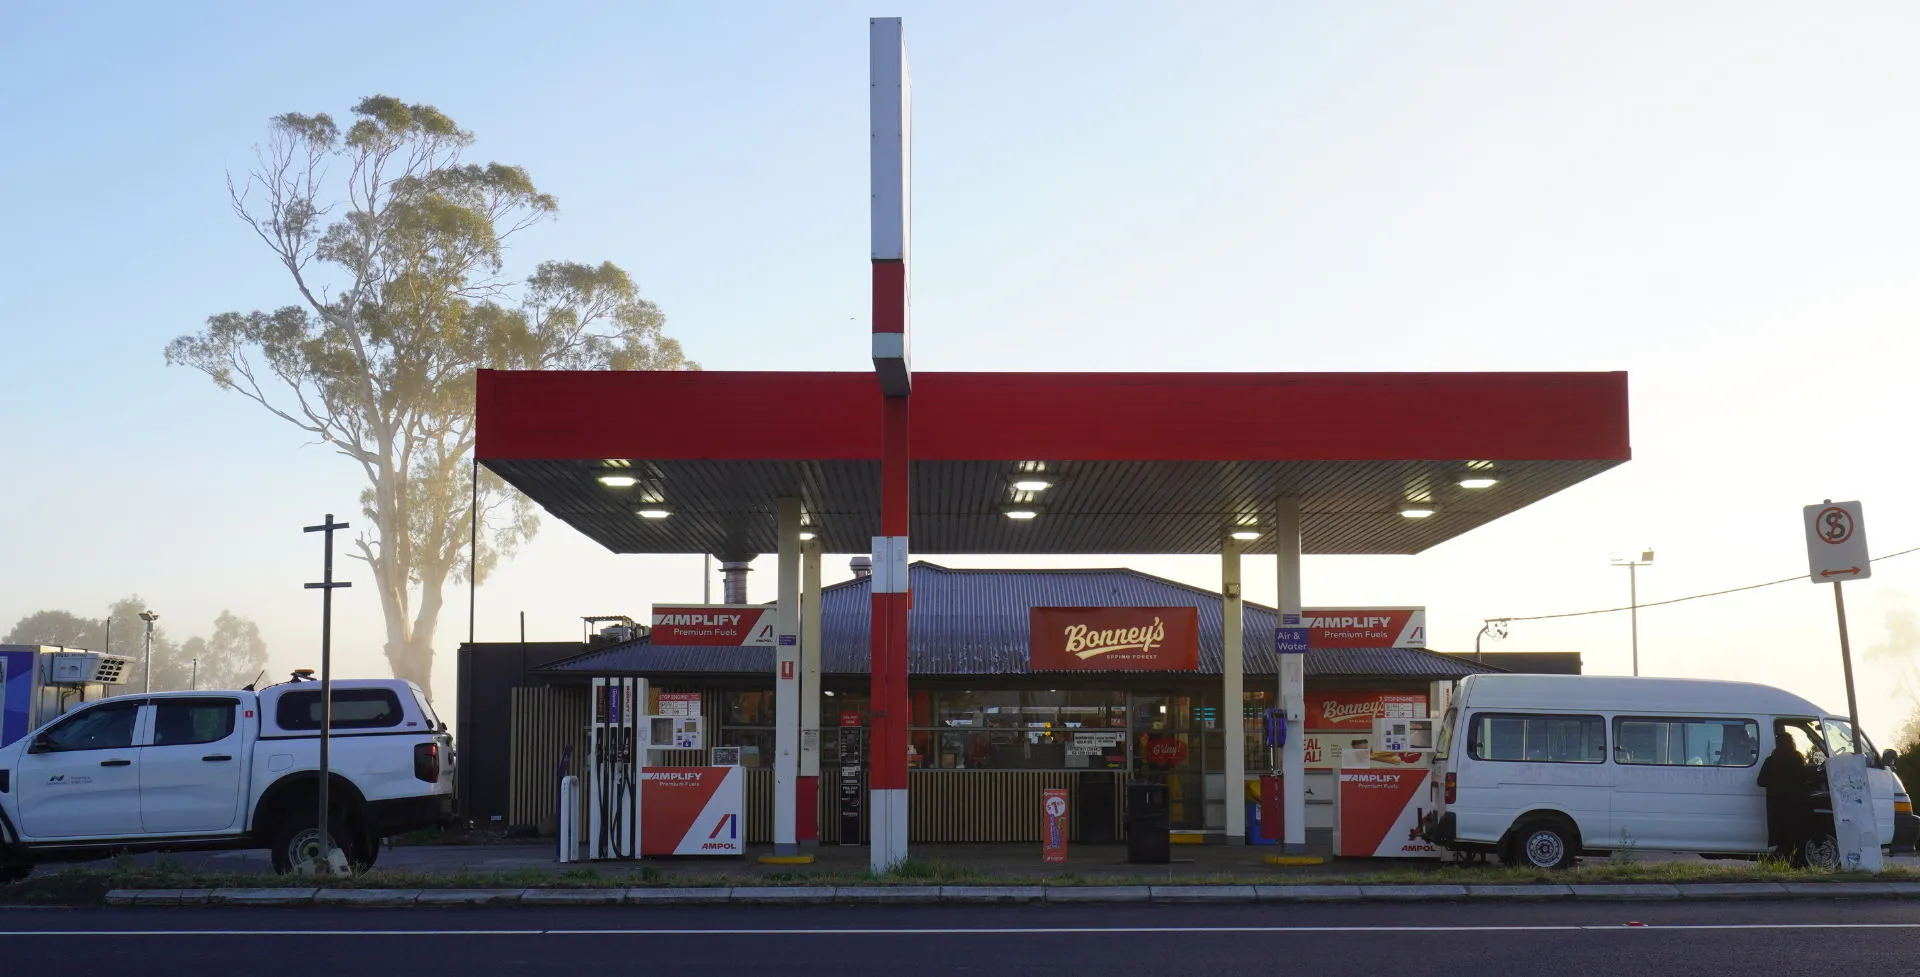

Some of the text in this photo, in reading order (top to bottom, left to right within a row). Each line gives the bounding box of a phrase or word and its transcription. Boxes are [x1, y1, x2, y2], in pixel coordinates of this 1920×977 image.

[660, 614, 741, 626] AMPLIFY
[1311, 616, 1391, 628] AMPLIFY
[673, 628, 737, 636] Premium Fuels
[1064, 616, 1165, 653] Bonney's
[1277, 631, 1301, 640] Air &
[1324, 630, 1388, 639] Premium Fuels
[1277, 642, 1308, 651] Water
[652, 772, 702, 780] AMPLIFY
[1351, 774, 1400, 782] AMPLIFY
